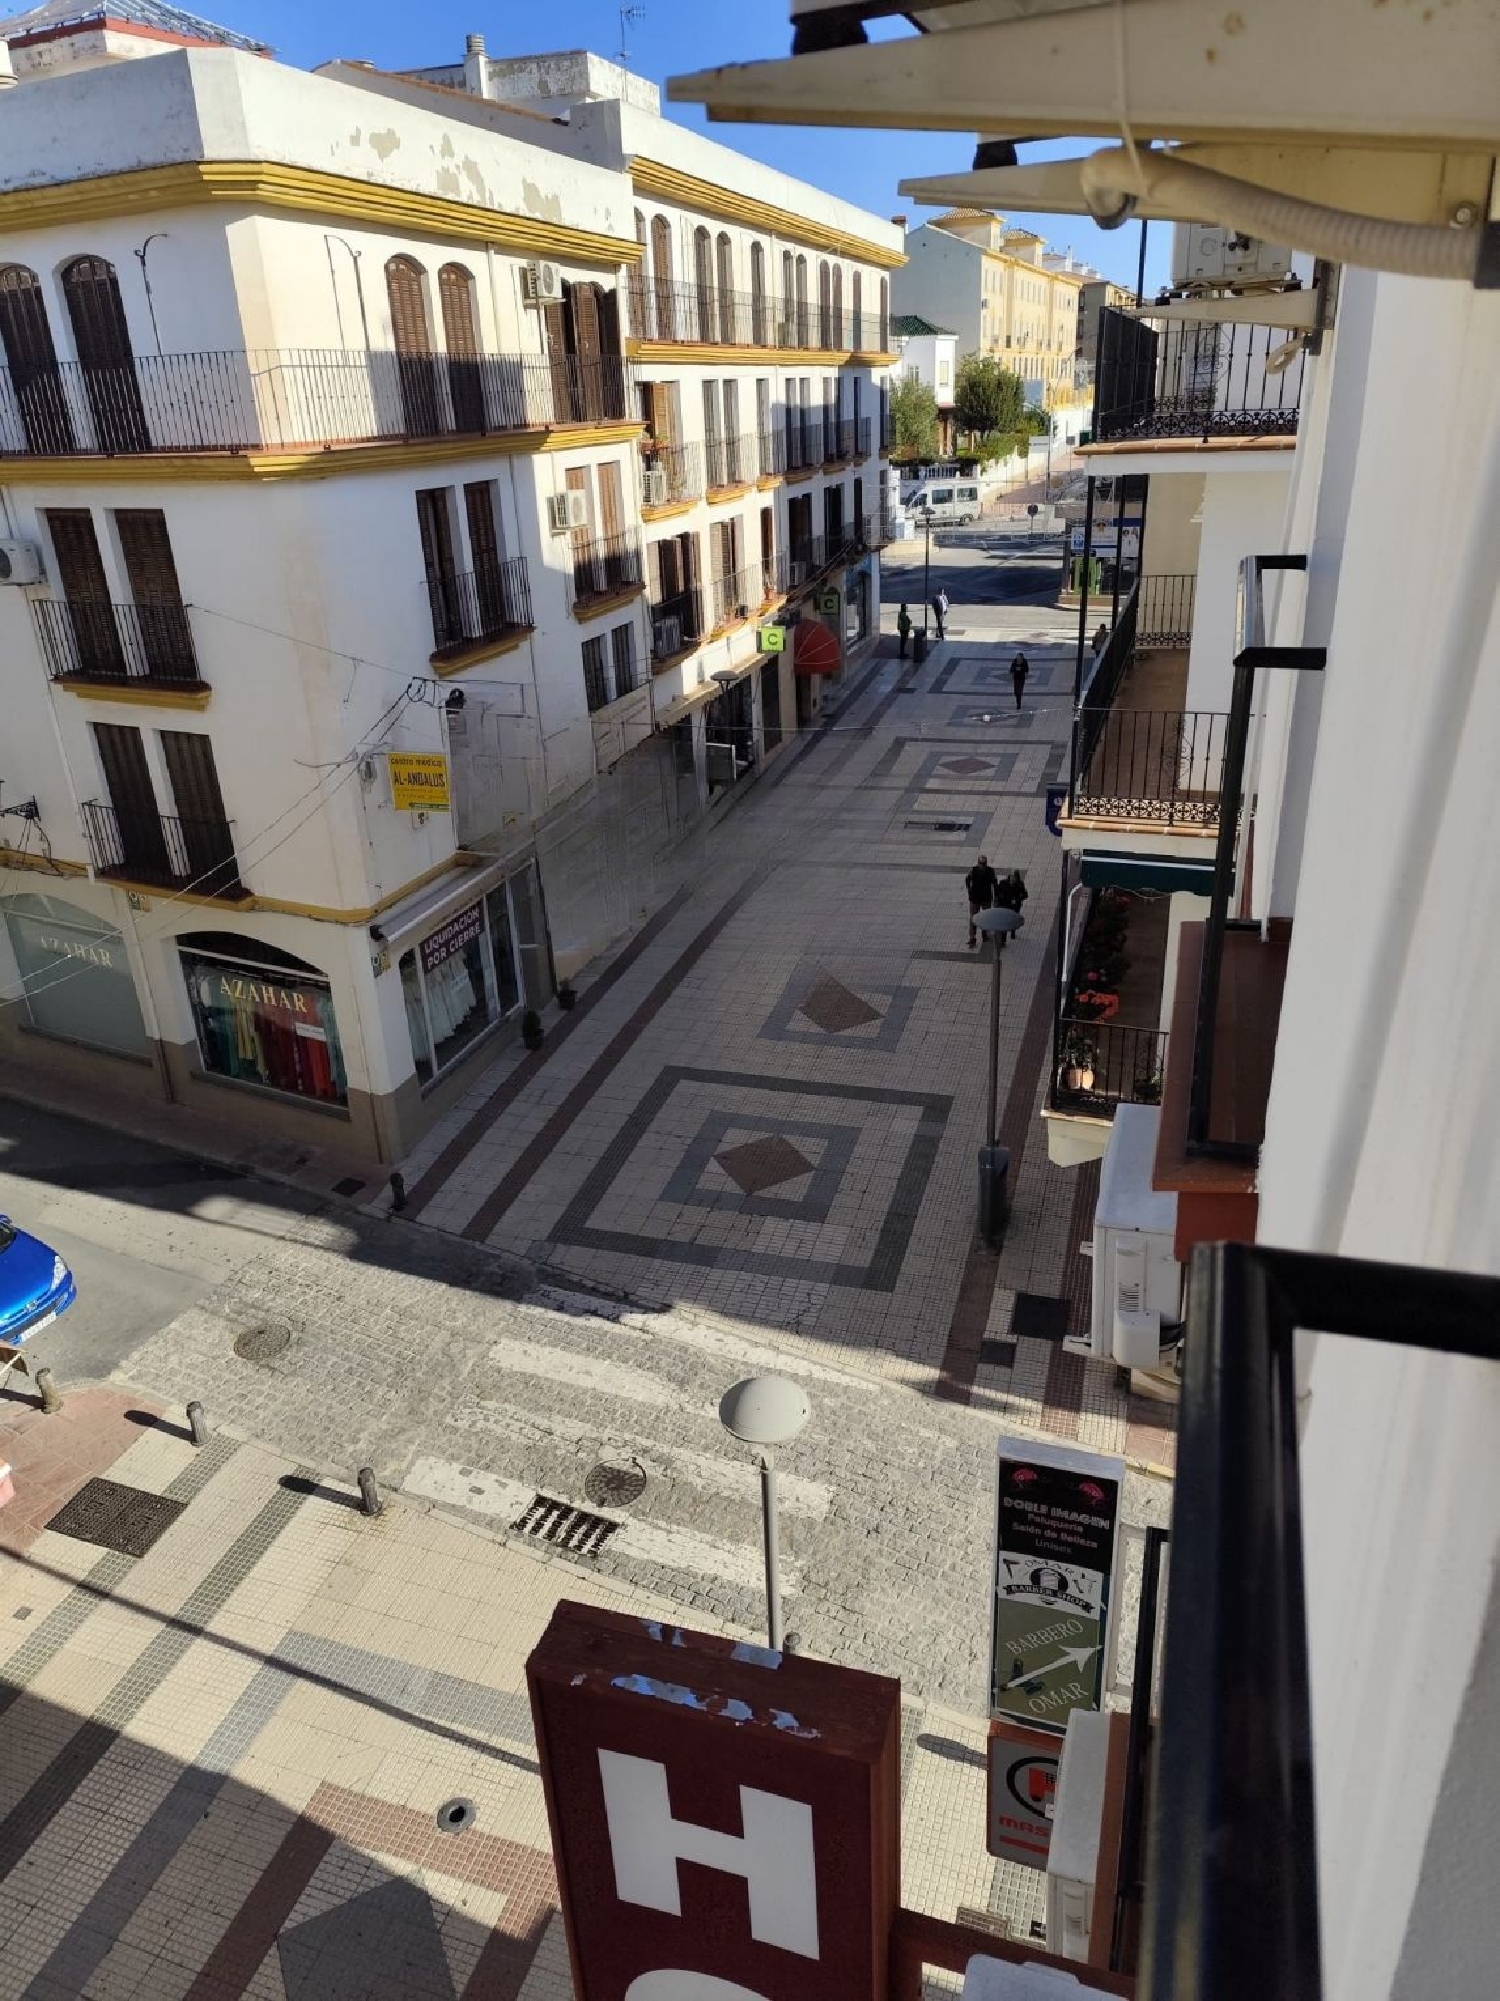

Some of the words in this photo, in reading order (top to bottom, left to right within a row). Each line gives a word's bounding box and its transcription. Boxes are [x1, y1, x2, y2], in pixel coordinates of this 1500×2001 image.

[767, 633, 779, 646] C
[427, 947, 447, 970] POR
[449, 921, 481, 953] CIERRE
[220, 975, 308, 1014] AZAHAR
[1006, 1618, 1084, 1656] BARBERO
[1028, 1682, 1089, 1714] OMAR
